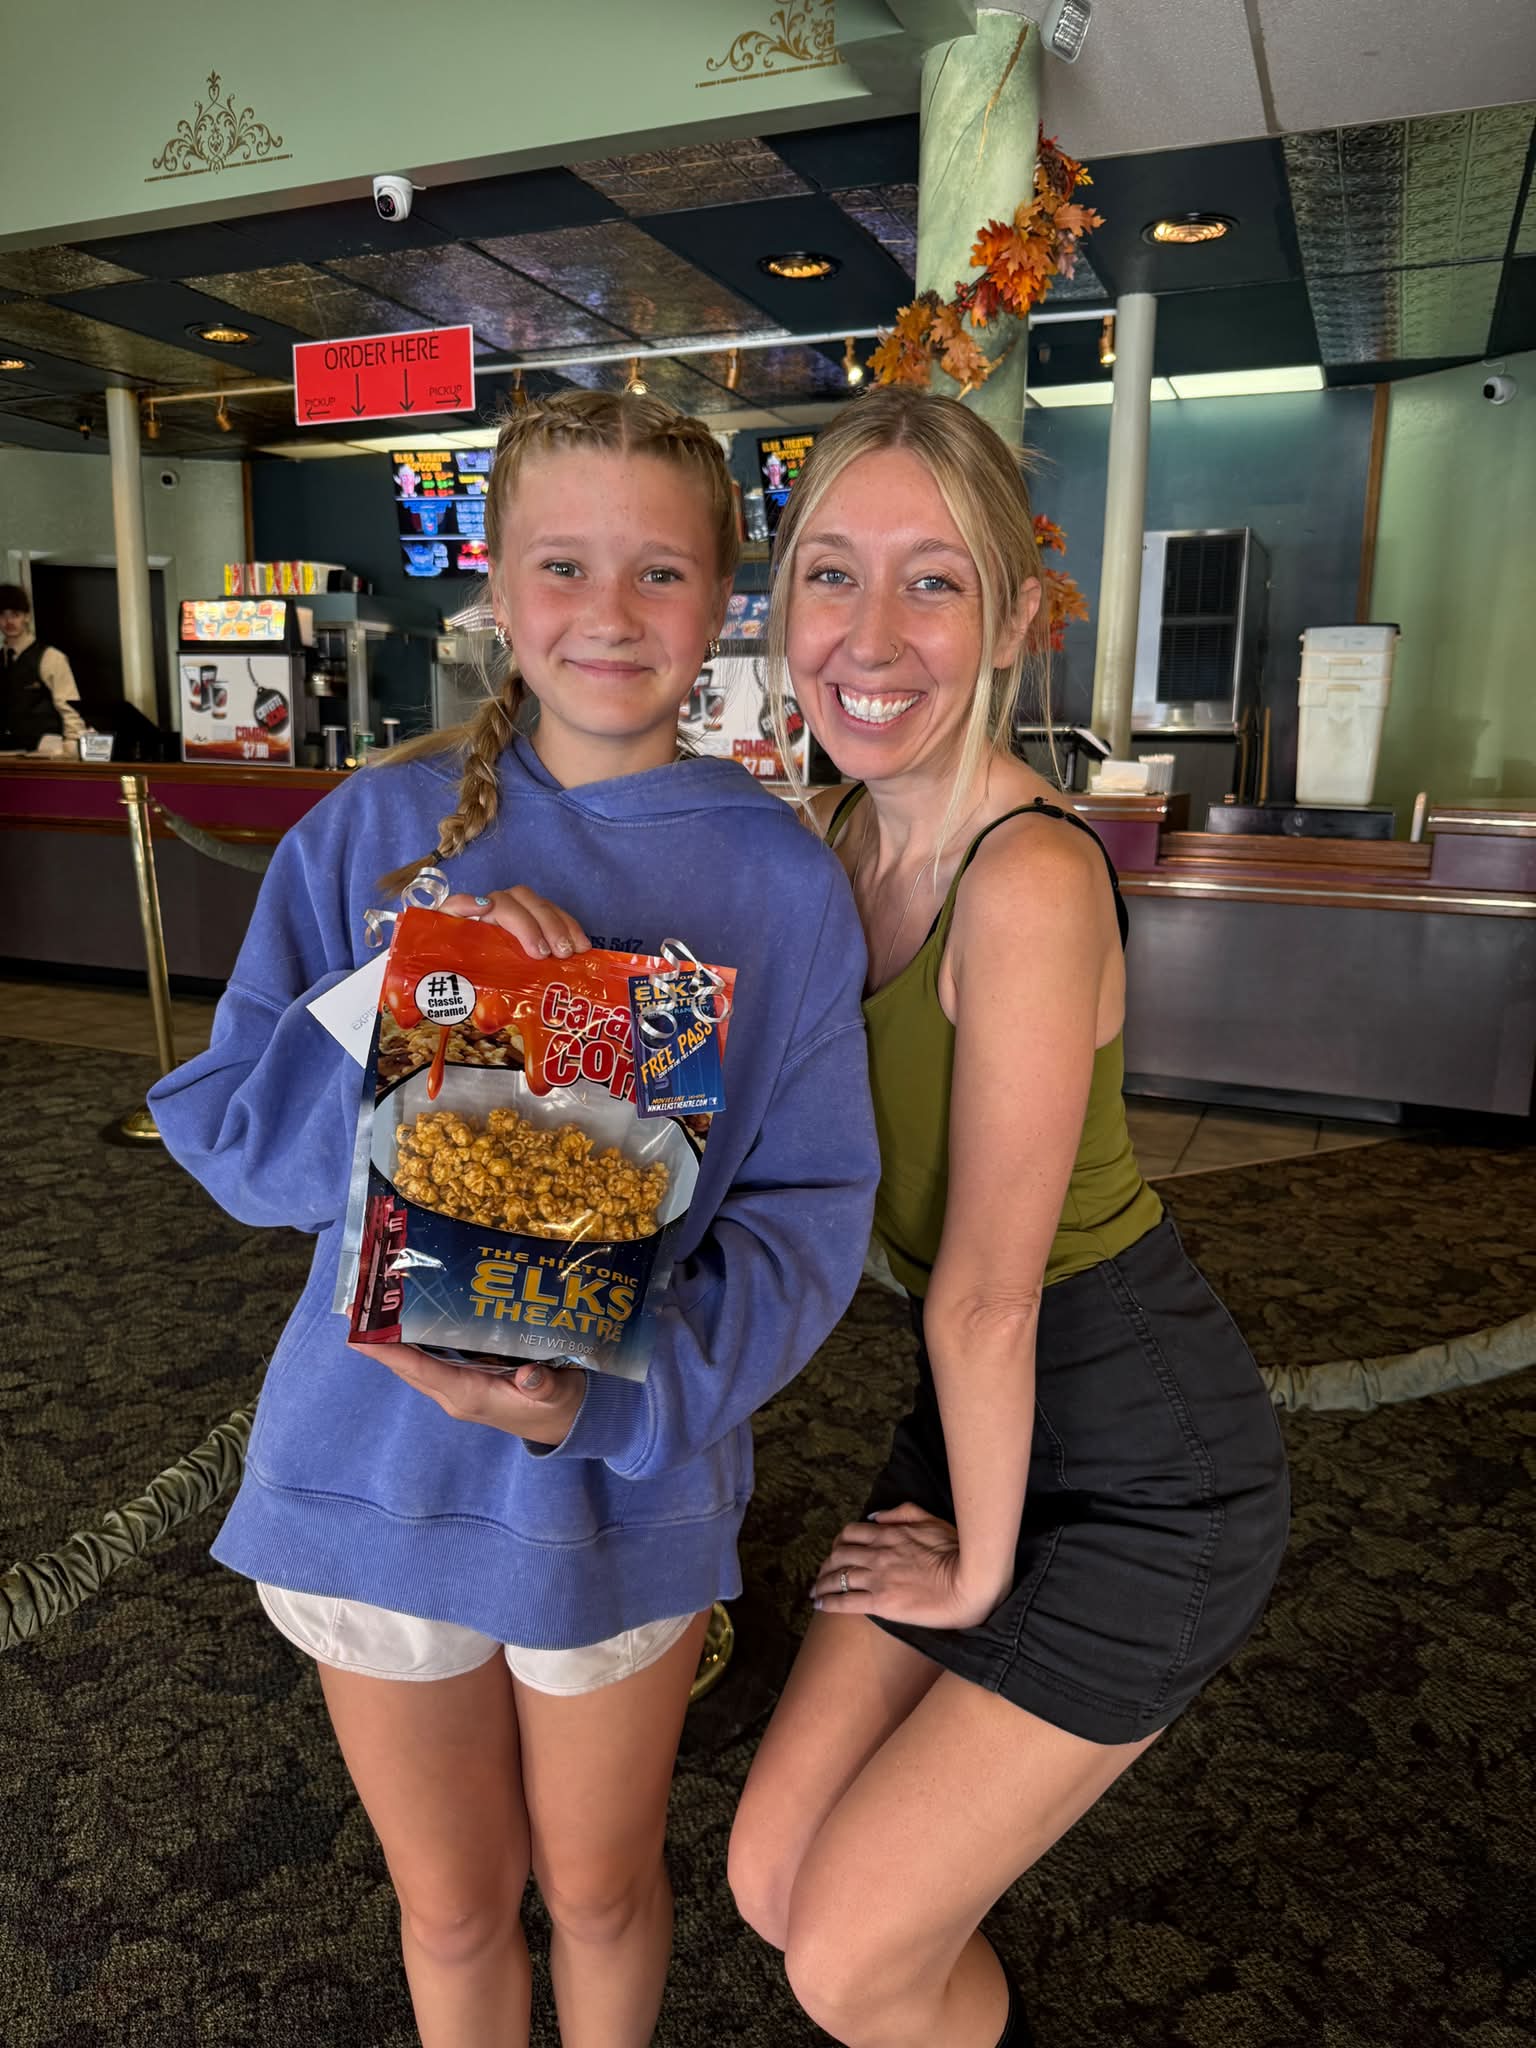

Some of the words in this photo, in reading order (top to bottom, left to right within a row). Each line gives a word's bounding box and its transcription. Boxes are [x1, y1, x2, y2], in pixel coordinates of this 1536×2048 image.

[324, 341, 386, 370] ORDER
[391, 336, 440, 364] HERE
[428, 384, 463, 397] PICKUP
[428, 975, 459, 997] #1
[634, 980, 704, 1002] ELK
[427, 1005, 468, 1018] Caramel
[428, 996, 463, 1008] Classic
[640, 1044, 676, 1086] FREE
[677, 1020, 713, 1056] PASS
[478, 1246, 530, 1263] THE
[539, 1255, 639, 1288] HISTORIC
[470, 1259, 635, 1322] ELKS
[469, 1294, 625, 1343] THEATRE
[519, 1333, 545, 1346] NET
[547, 1337, 568, 1349] WT
